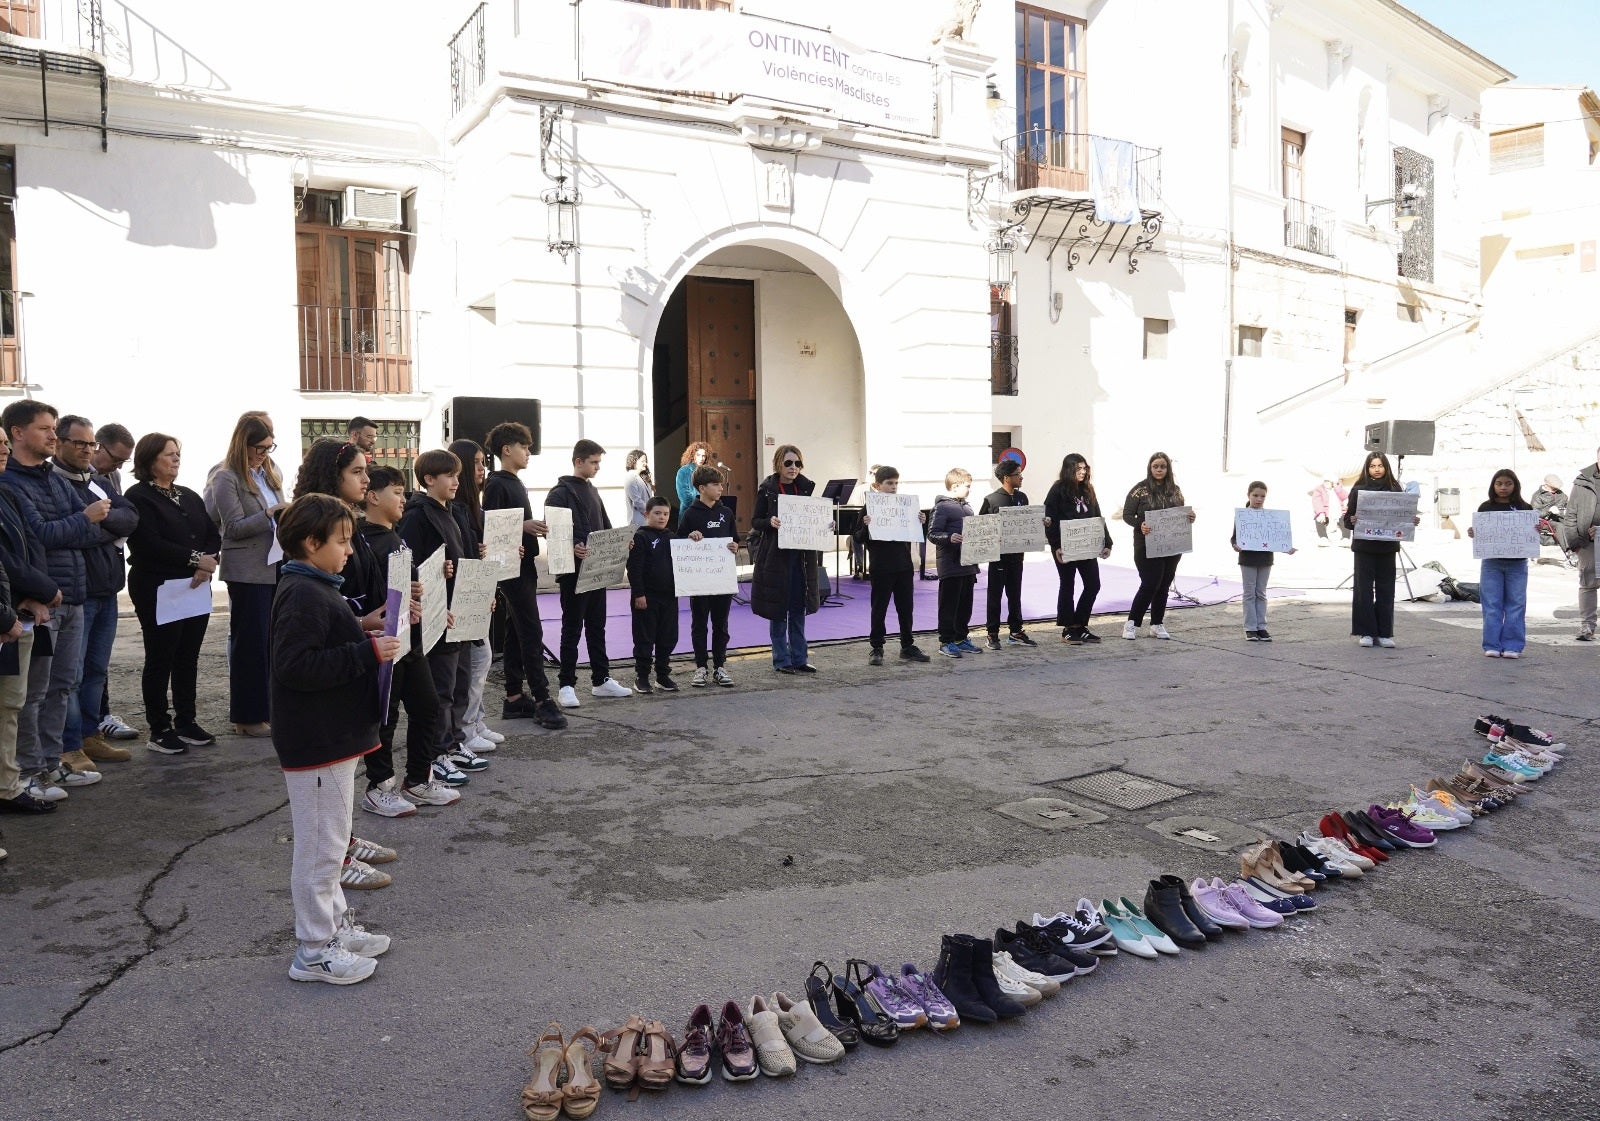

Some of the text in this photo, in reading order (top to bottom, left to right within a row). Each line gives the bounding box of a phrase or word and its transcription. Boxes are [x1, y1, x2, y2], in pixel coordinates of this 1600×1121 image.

[748, 30, 902, 86] ONTINYENT contra les
[762, 59, 890, 108] Violències Masclistes
